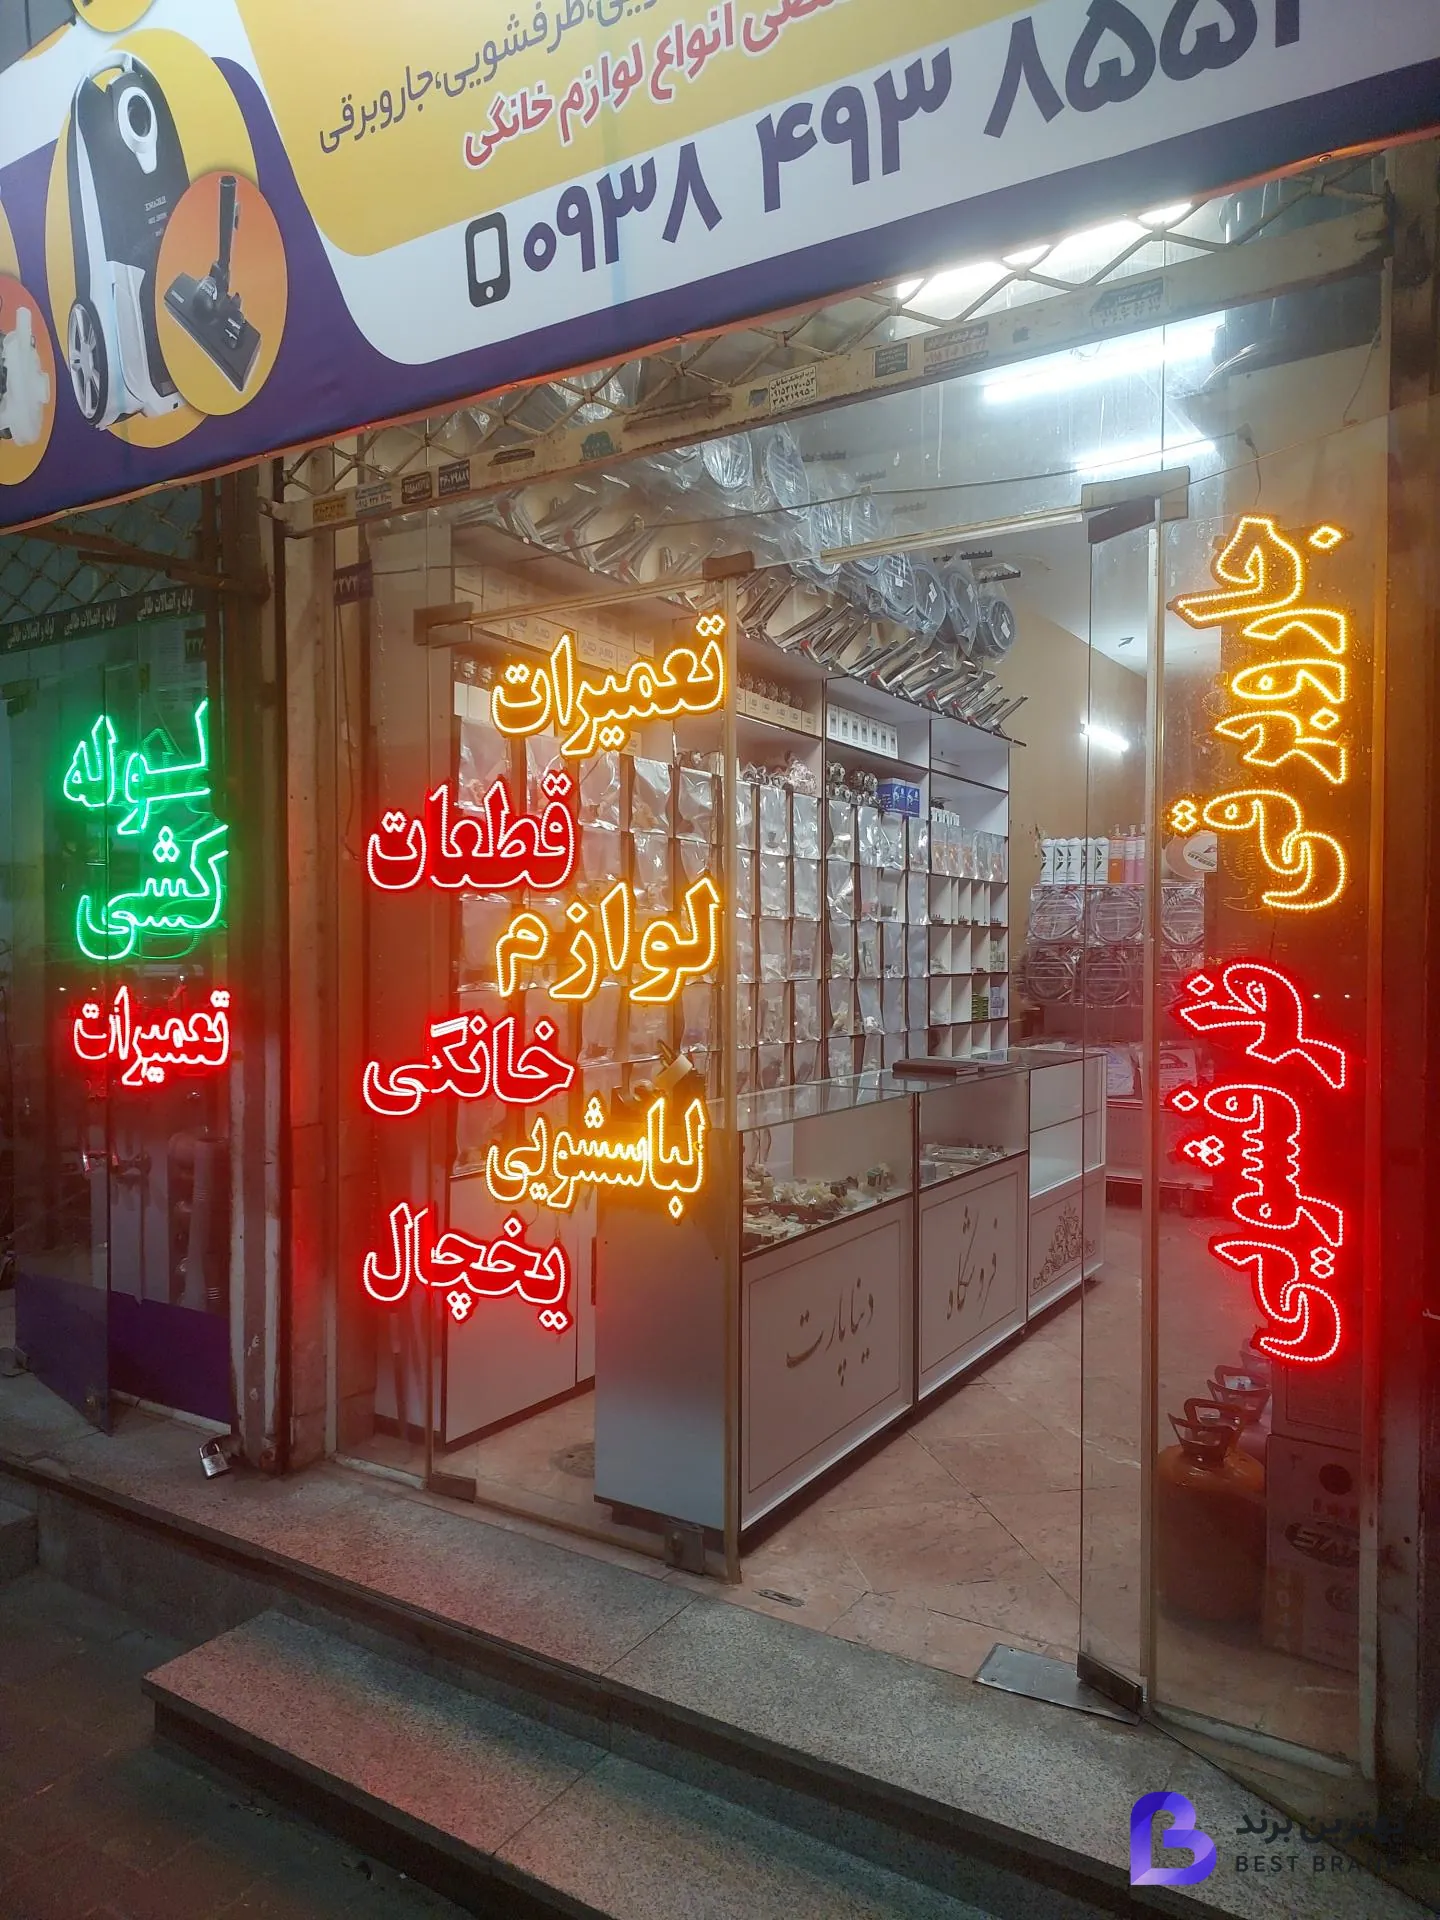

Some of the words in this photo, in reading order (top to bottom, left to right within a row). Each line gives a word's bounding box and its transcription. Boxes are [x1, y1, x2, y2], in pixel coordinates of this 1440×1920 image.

[319, 66, 434, 154] جاروبرقی
[560, 42, 643, 143] لوازم
[650, 1, 734, 100] انواع
[464, 84, 554, 166] خانگی
[523, 141, 722, 273] ۰۹۳۸
[756, 48, 951, 213] ۴۹۳
[491, 614, 726, 757] تعمیرات
[1171, 515, 1348, 910] جاروبرقی
[63, 697, 211, 834] لوله
[76, 824, 230, 960] کشی
[366, 771, 576, 890] قطعات
[495, 877, 722, 1002] لوازم
[73, 985, 231, 1087] تعمیرات
[363, 1015, 575, 1115] خانگی
[486, 1097, 707, 1218] لباسشویی
[1171, 962, 1346, 1362] ظرفشویی
[364, 1201, 569, 1330] یخچال
